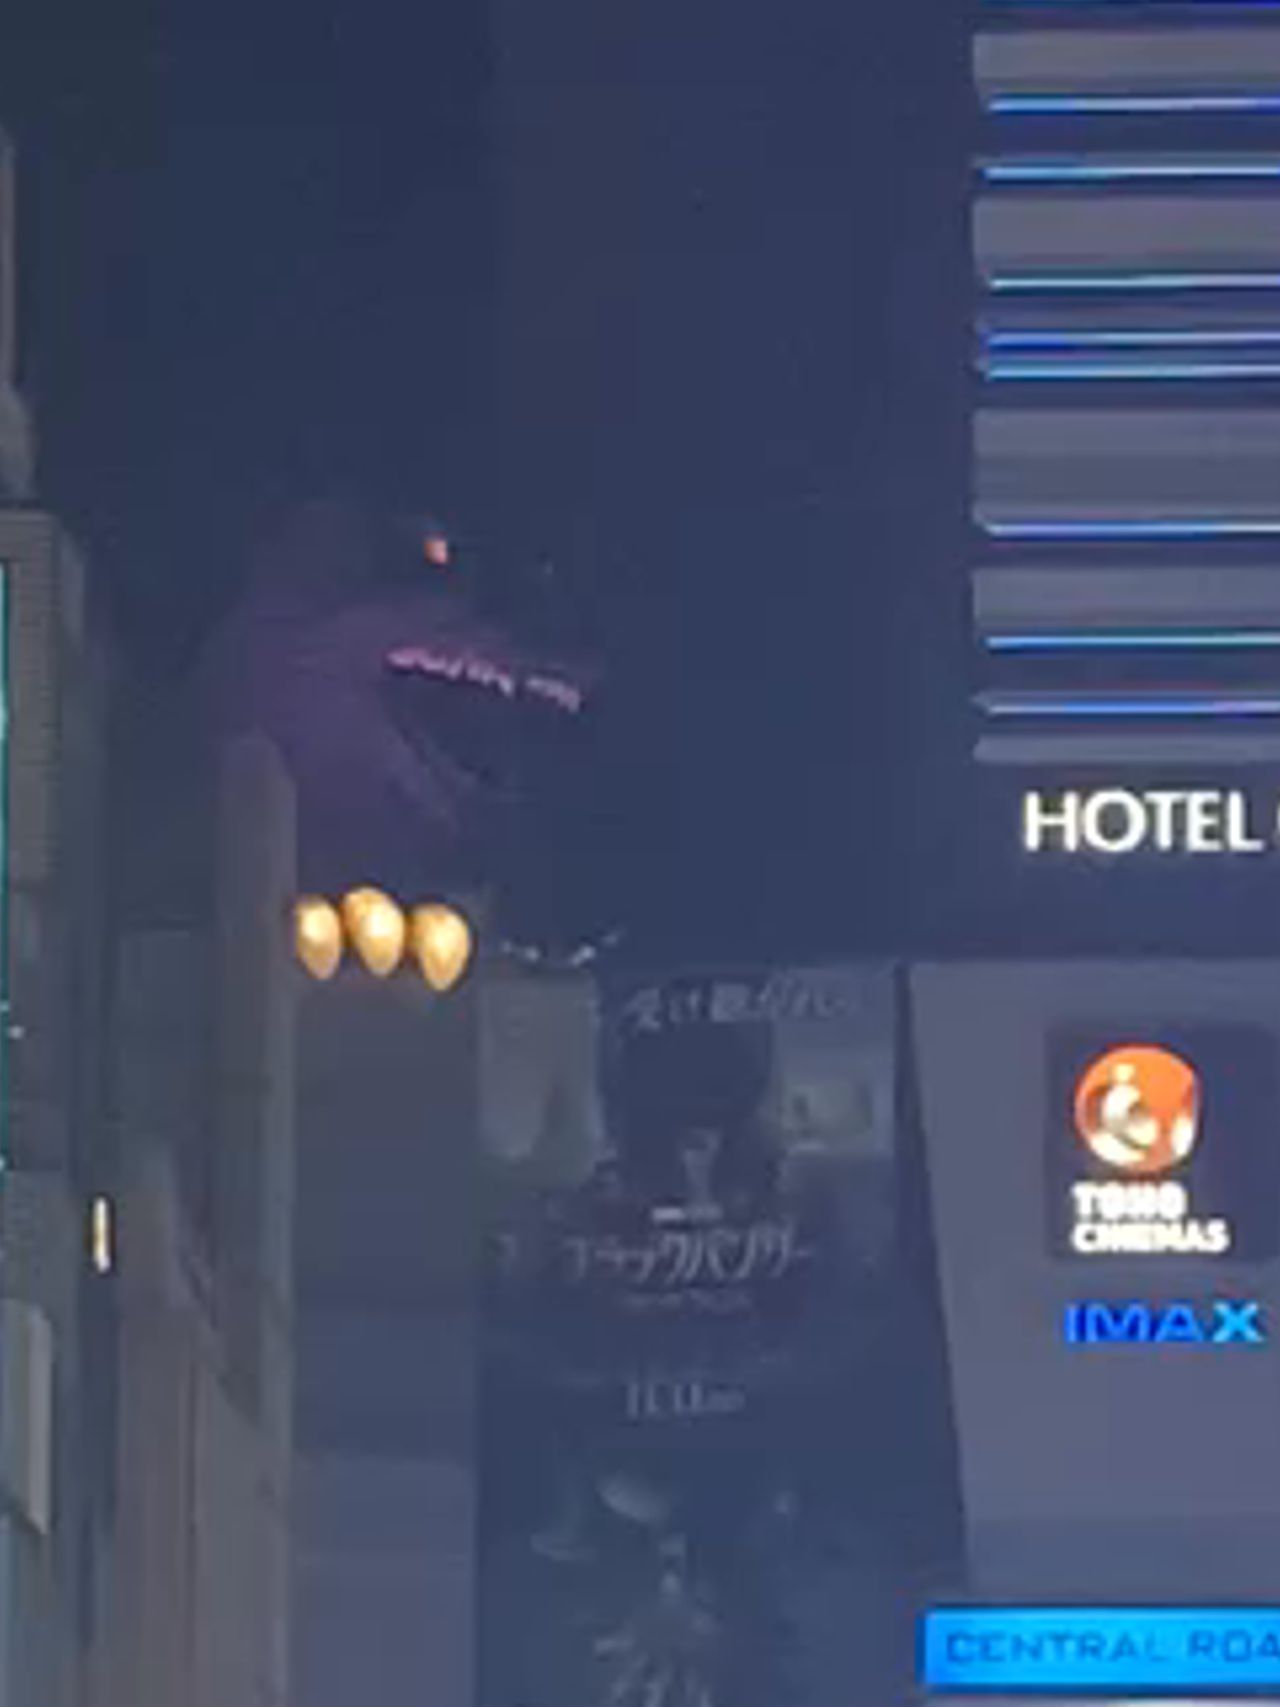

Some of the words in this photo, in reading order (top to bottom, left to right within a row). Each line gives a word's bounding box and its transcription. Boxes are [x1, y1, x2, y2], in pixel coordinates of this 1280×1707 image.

[1023, 790, 1263, 853] HOTEL
[1071, 1181, 1186, 1220] TOHO
[1071, 1219, 1230, 1254] CINEMAS
[1063, 1301, 1266, 1344] IMAX
[945, 1630, 1170, 1665] CENTRAL
